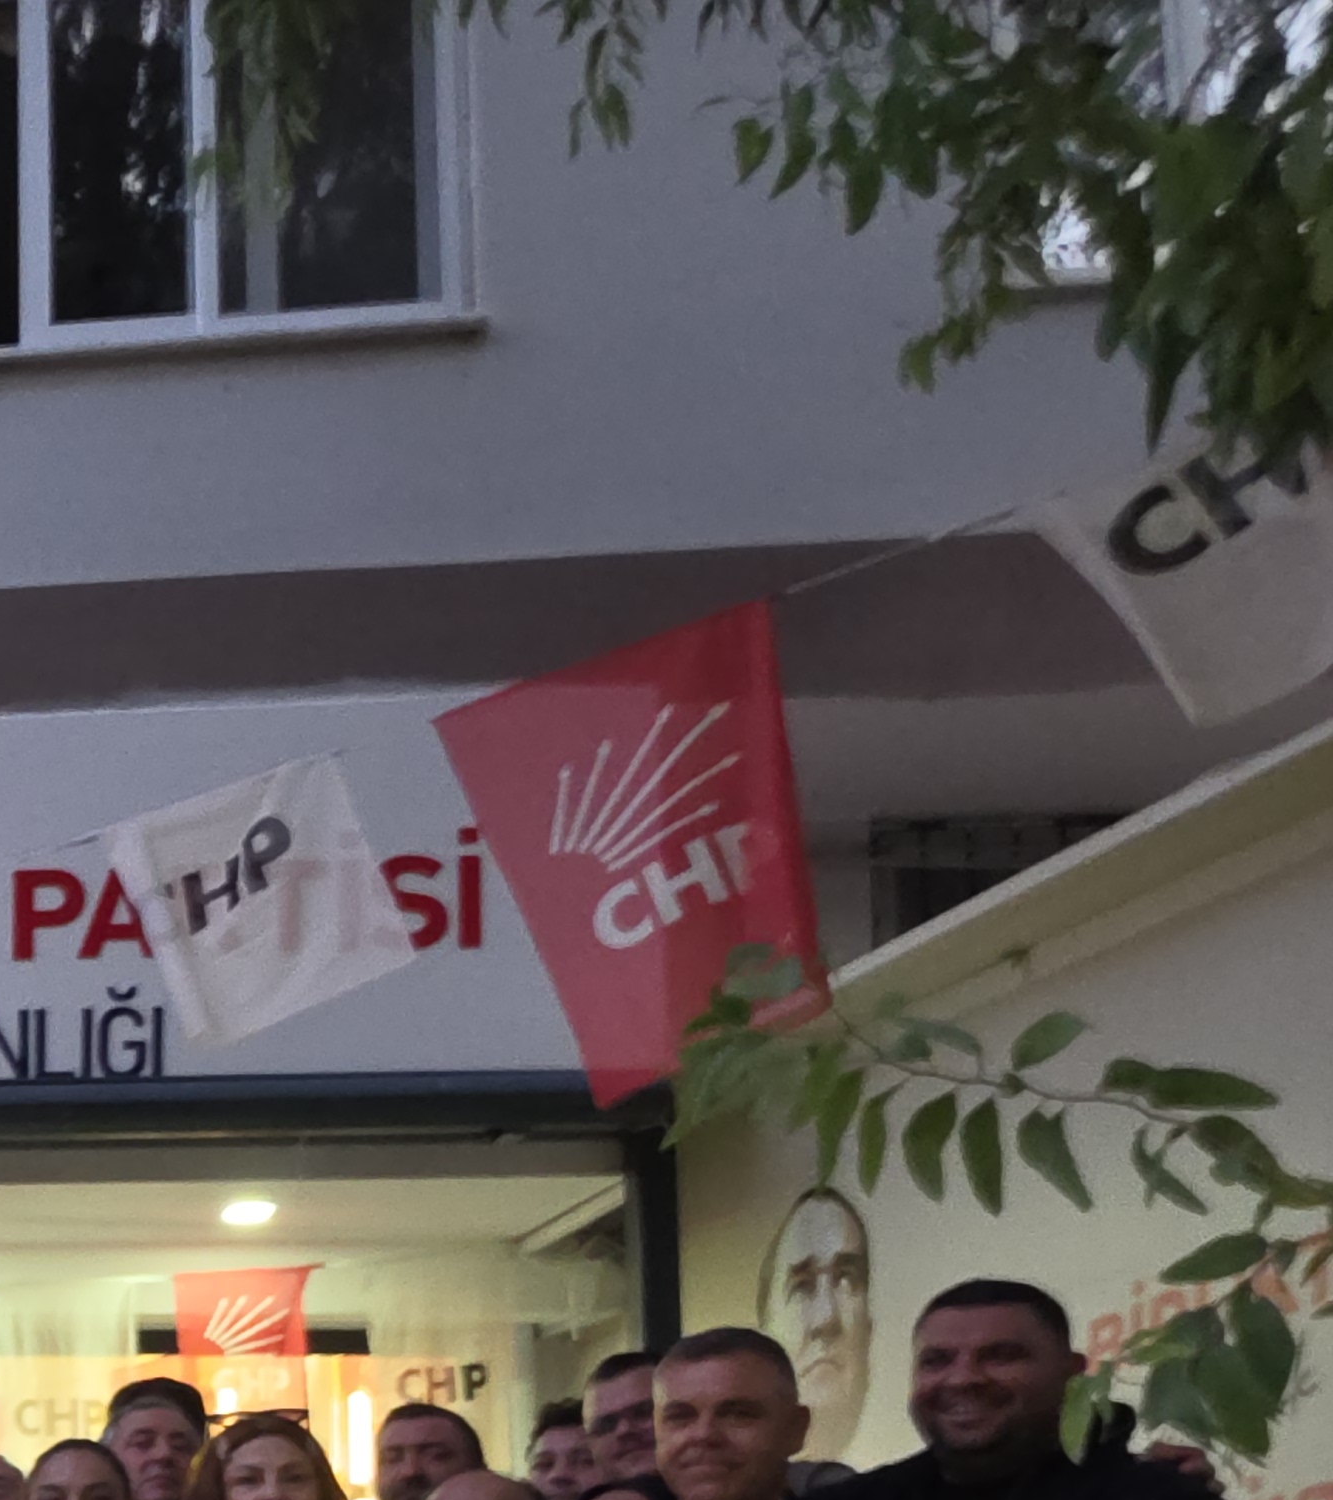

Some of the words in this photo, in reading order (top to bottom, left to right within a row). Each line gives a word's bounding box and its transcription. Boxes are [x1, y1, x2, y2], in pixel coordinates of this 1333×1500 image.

[1107, 448, 1310, 577] CH
[165, 816, 291, 936] HP
[14, 1397, 107, 1437] CHP
[396, 1364, 487, 1403] CHP
